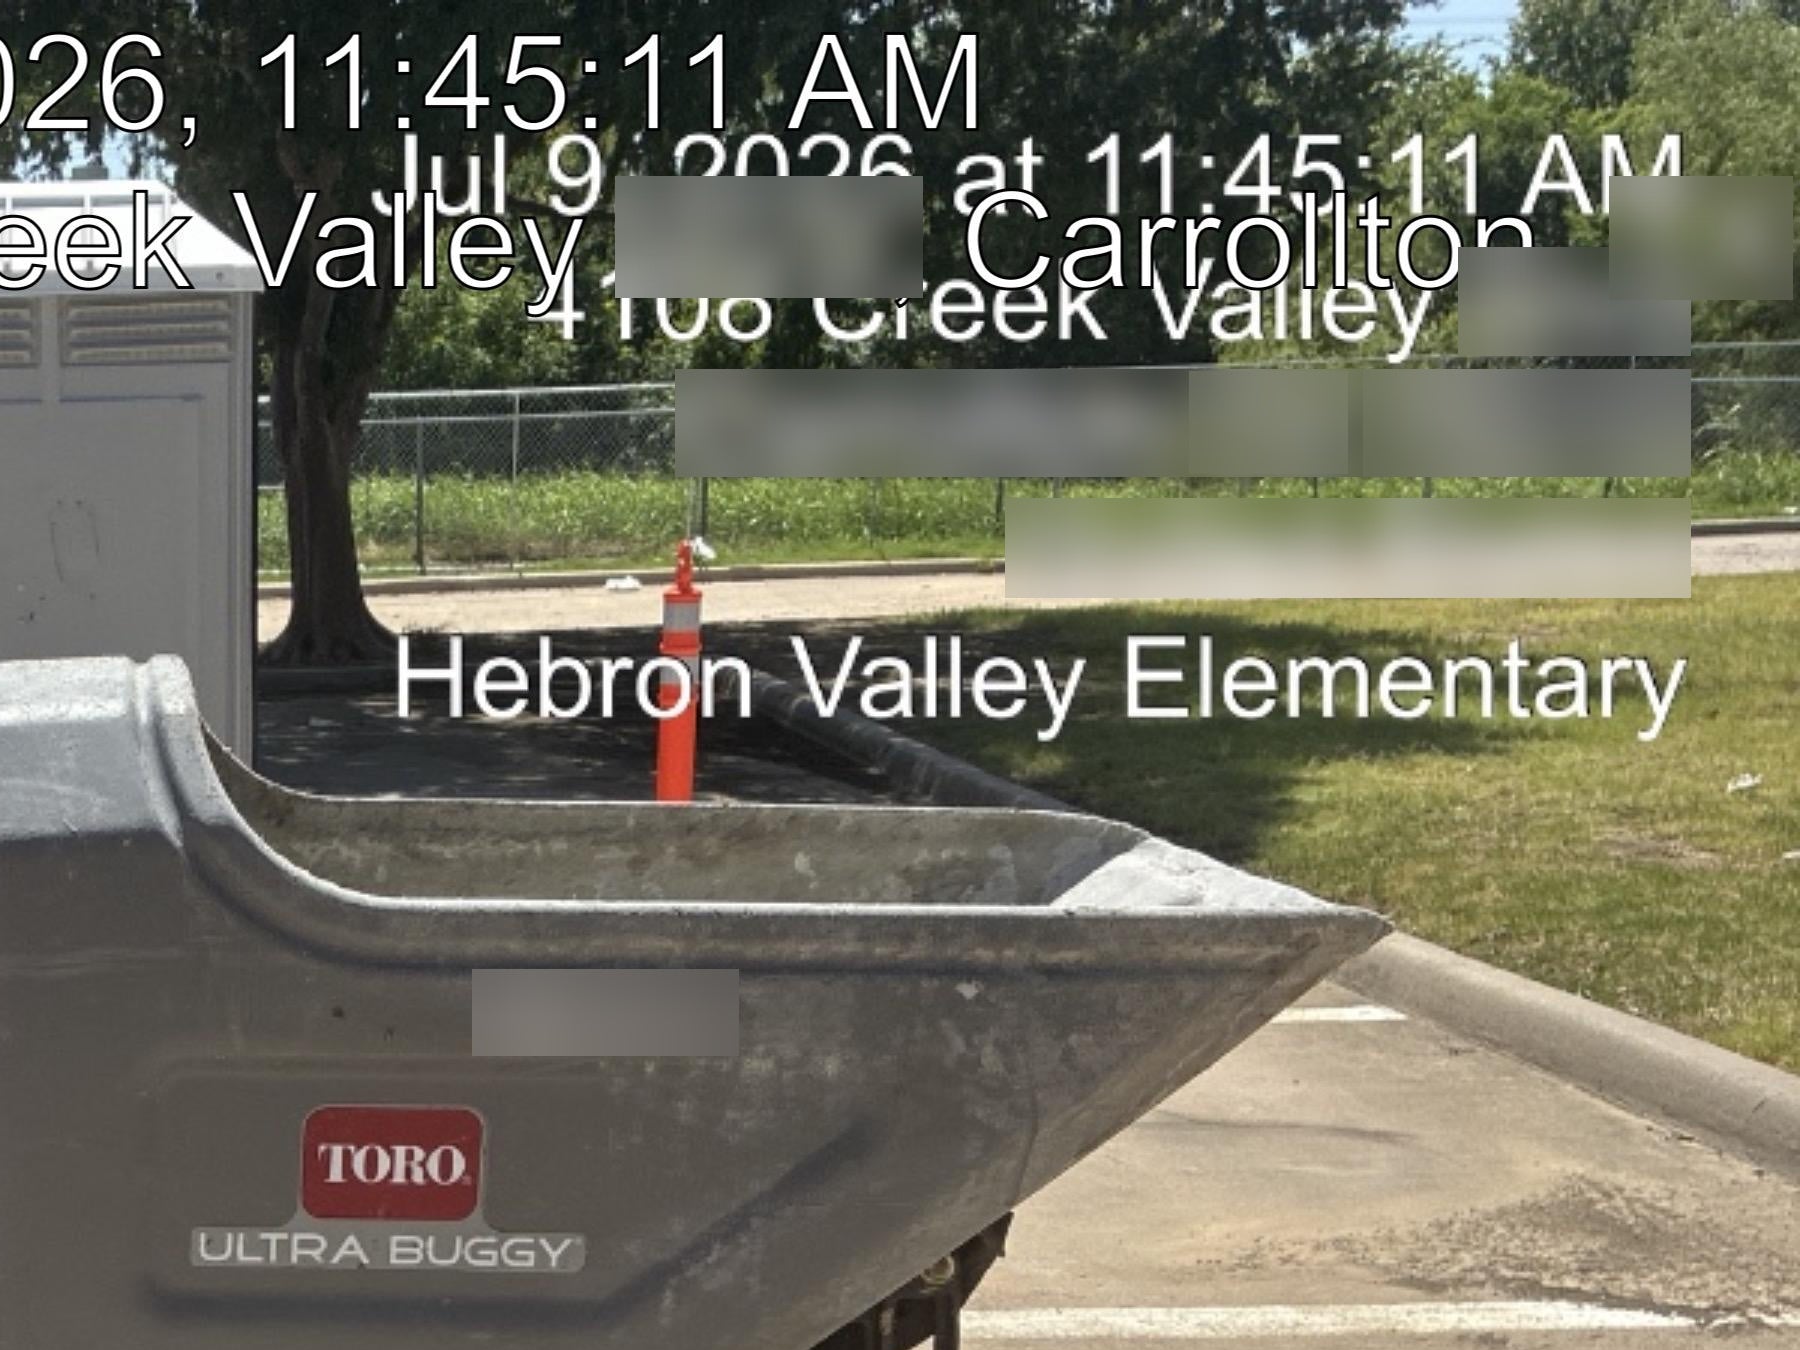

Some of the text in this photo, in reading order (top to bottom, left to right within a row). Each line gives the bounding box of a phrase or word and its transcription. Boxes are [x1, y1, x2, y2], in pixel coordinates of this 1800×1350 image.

[316, 1143, 467, 1186] TORO
[198, 1231, 575, 1268] ULTRA BUGGY
